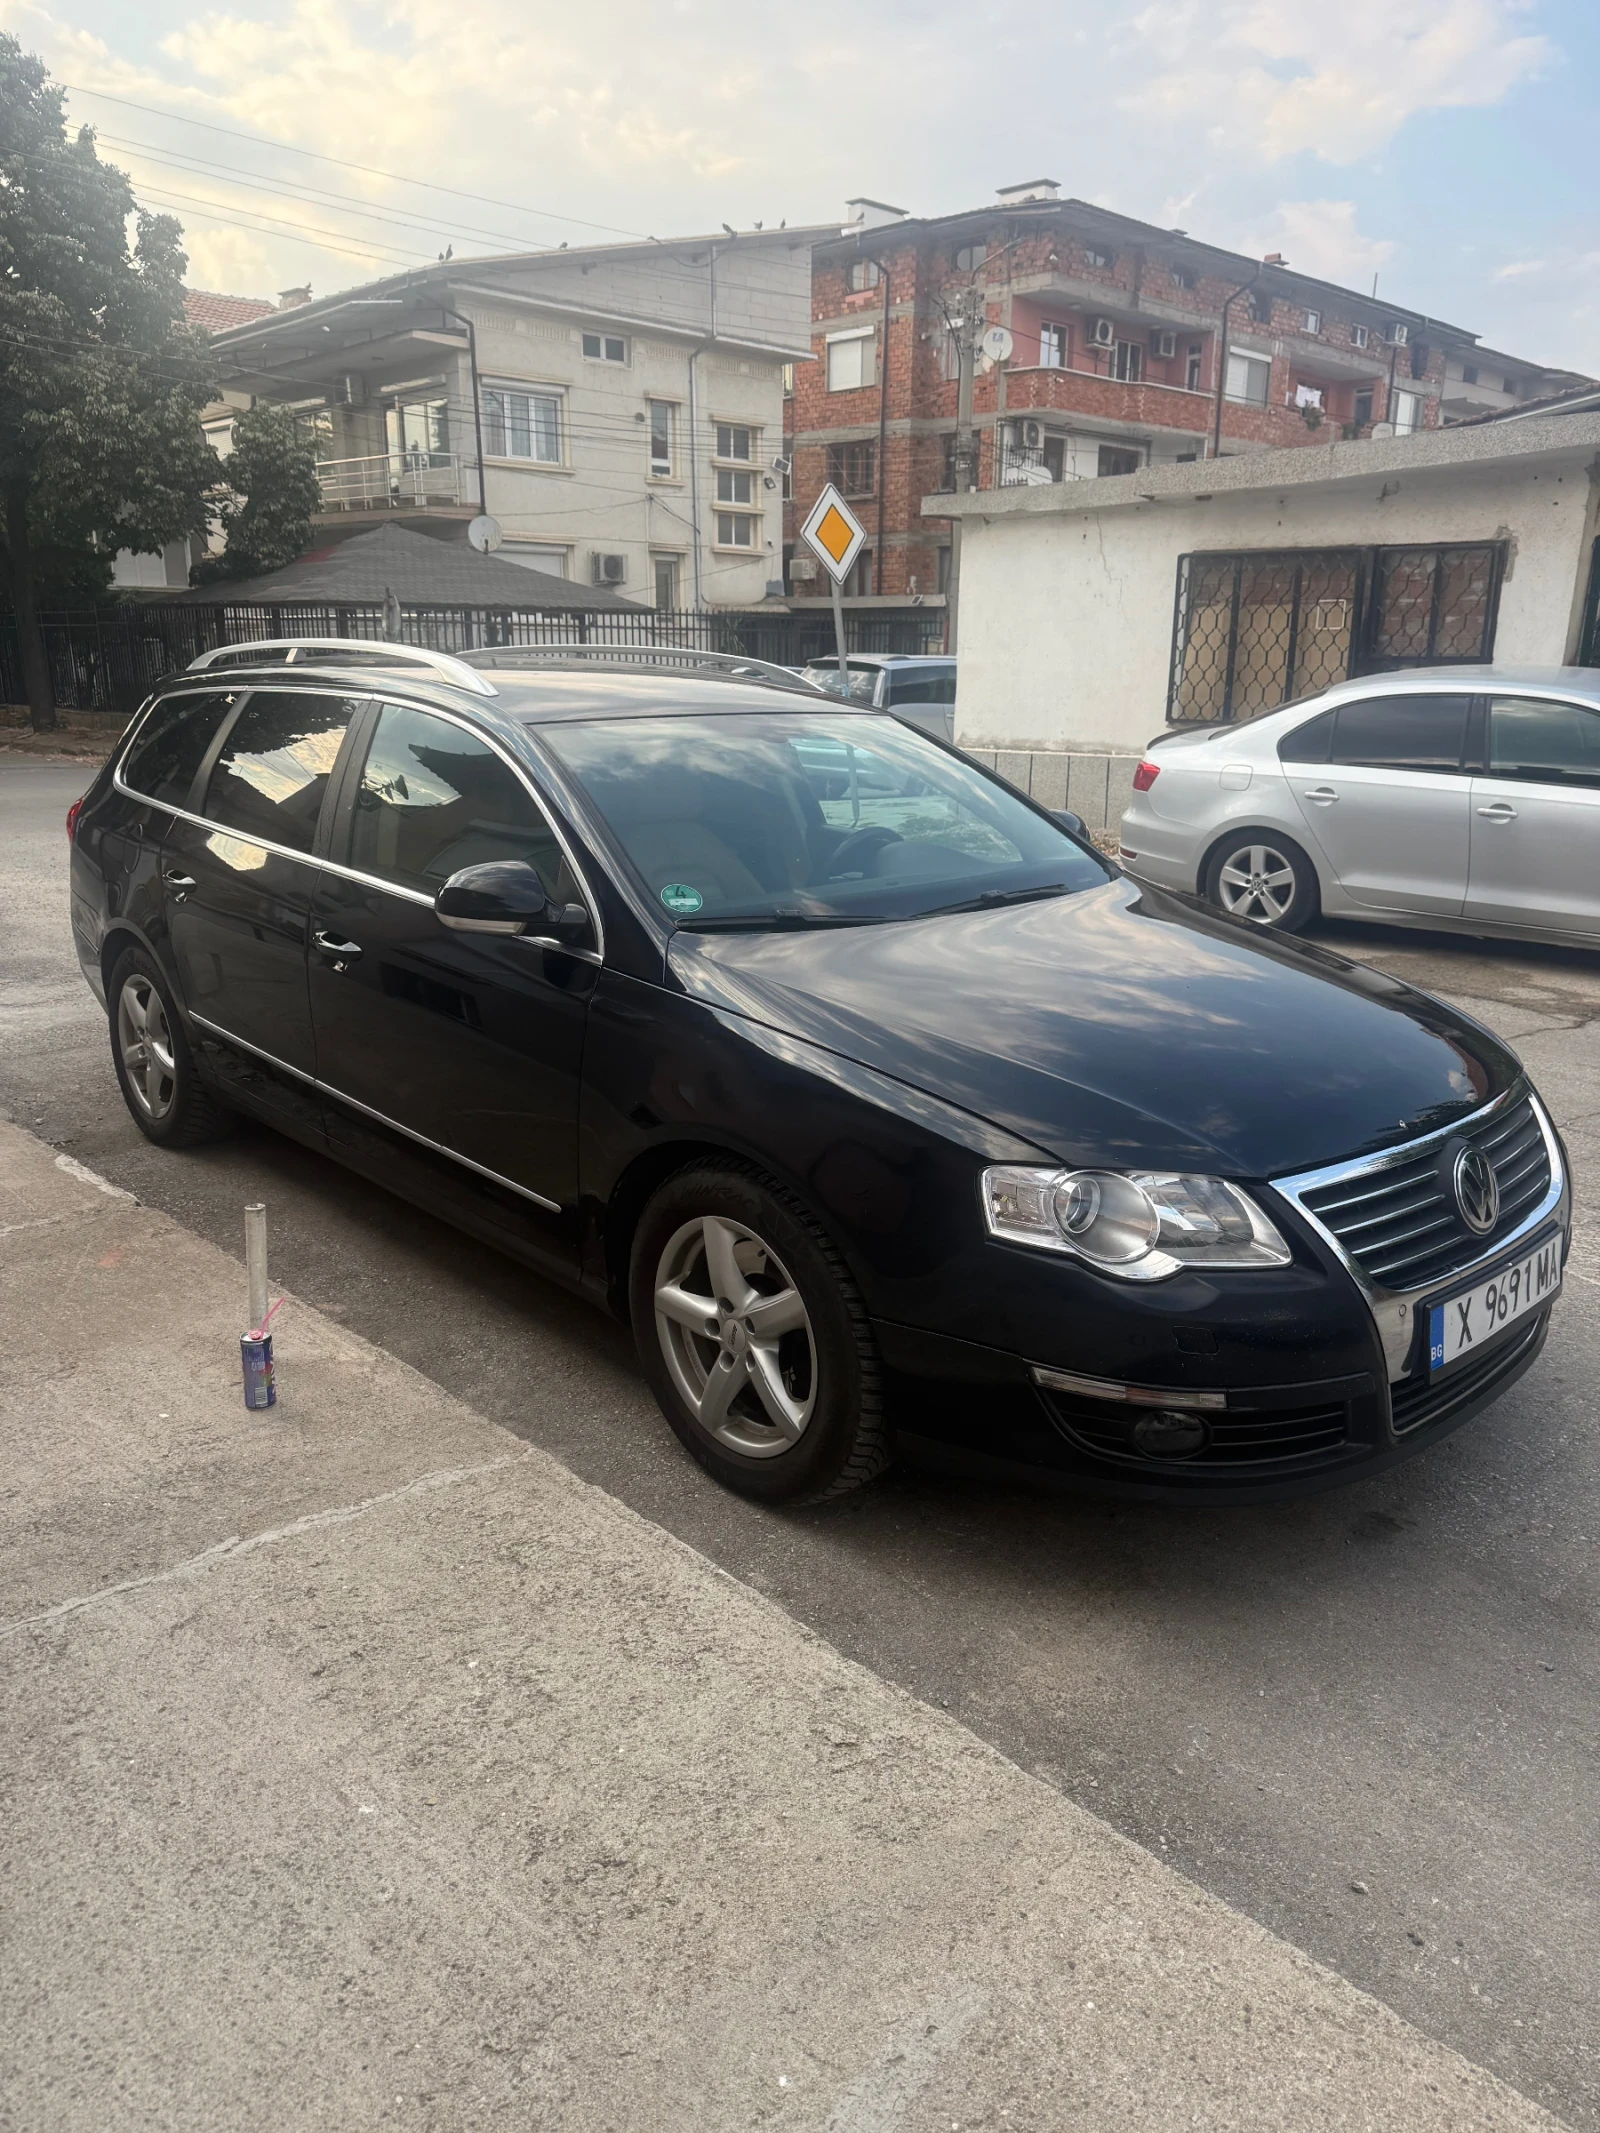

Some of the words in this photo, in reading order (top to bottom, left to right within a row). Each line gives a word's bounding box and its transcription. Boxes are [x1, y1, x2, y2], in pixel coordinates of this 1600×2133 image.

[675, 886, 686, 898] 4
[1457, 1296, 1473, 1349] X
[1486, 1260, 1531, 1330] 9691
[1536, 1242, 1557, 1296] MA
[1431, 1344, 1443, 1361] BG
